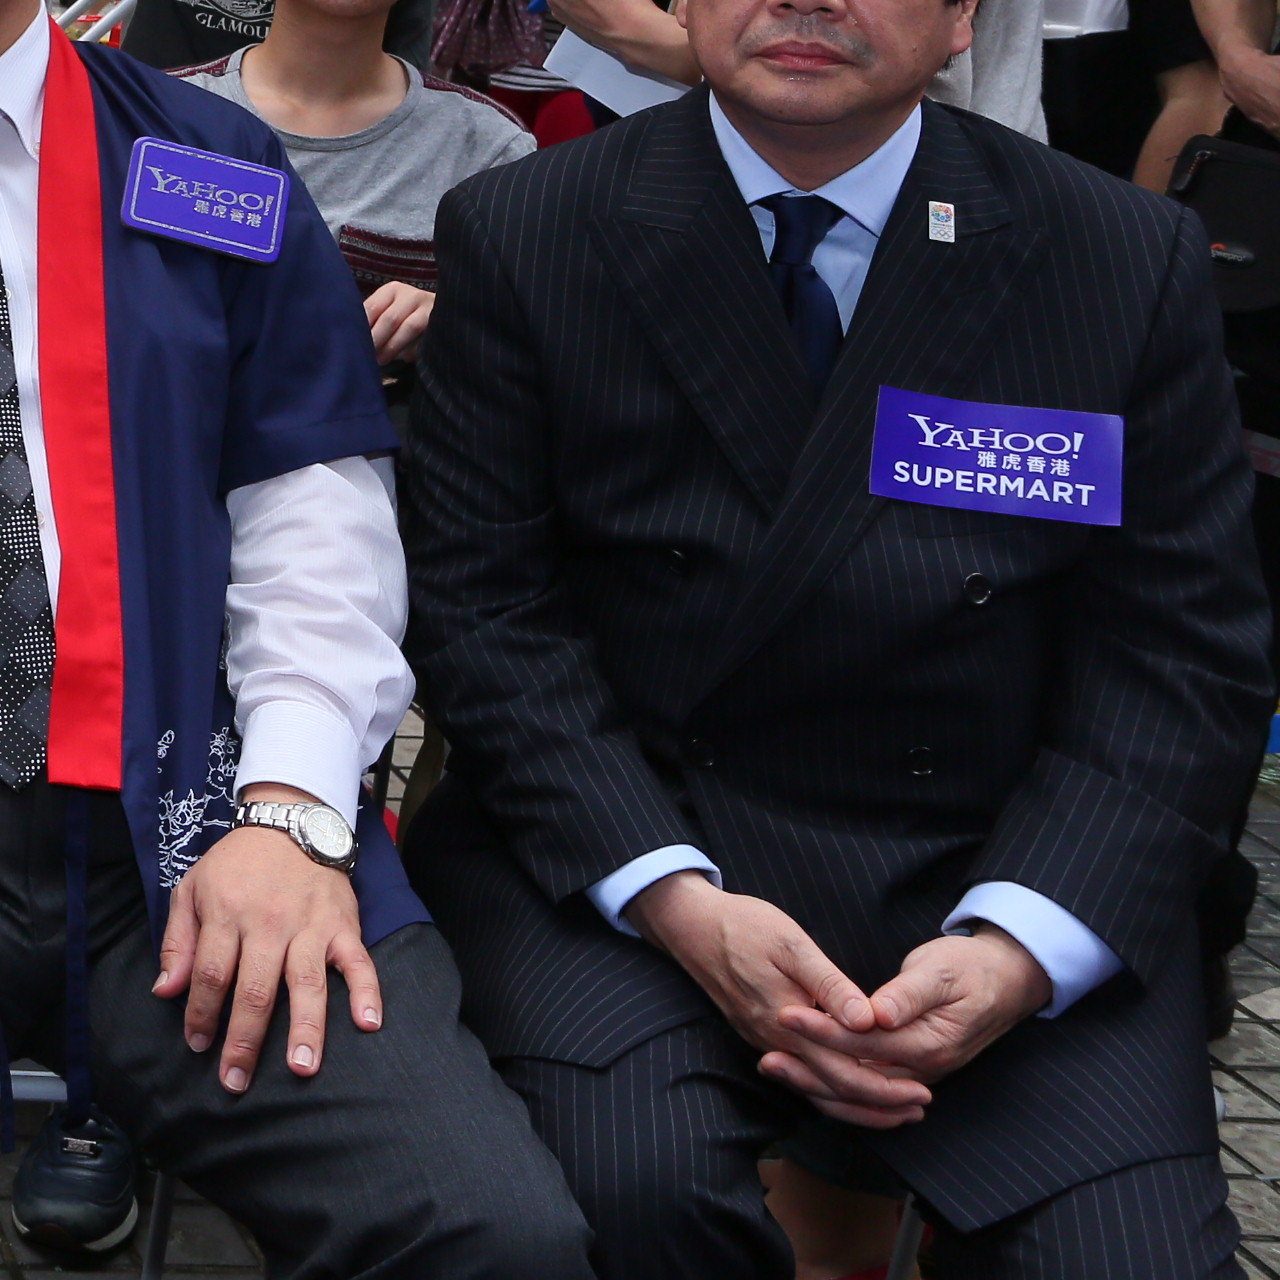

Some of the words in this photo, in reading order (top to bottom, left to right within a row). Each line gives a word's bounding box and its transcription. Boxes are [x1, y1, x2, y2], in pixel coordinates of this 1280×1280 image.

[144, 164, 276, 217] YAHOO!
[193, 198, 264, 229] 雅虎香港
[907, 413, 1086, 460] YAHOO!
[892, 460, 1096, 507] SUPERMART
[976, 450, 1072, 478] 雅虎香港
